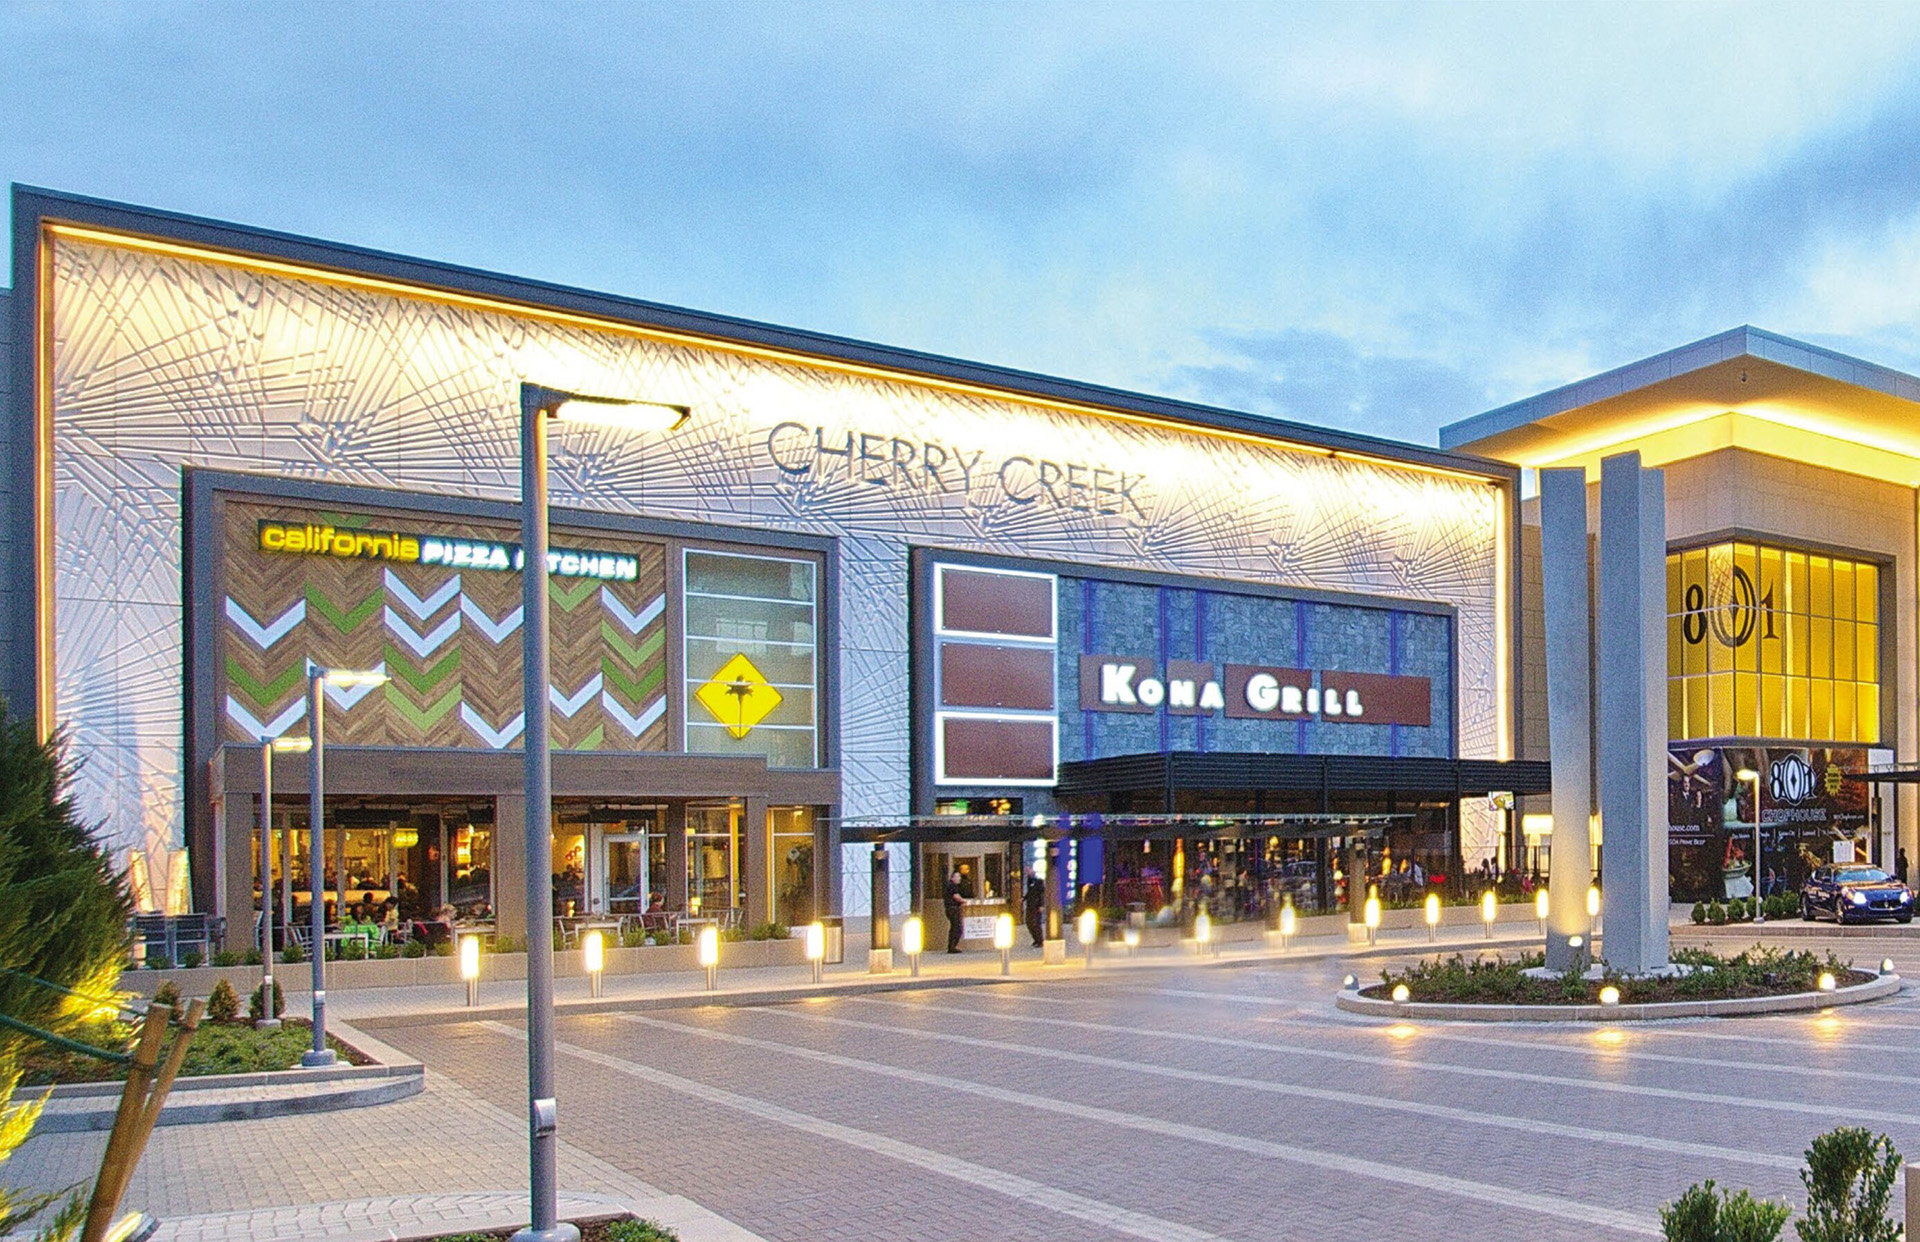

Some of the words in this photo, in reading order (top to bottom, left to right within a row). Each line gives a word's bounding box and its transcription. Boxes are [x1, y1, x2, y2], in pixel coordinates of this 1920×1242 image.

[767, 421, 984, 504] CHERRY
[999, 456, 1148, 519] CREEK
[262, 525, 420, 563] california
[421, 536, 511, 571] PIZZA
[514, 547, 638, 580] TCHEN
[1683, 564, 1780, 648] 801
[1100, 663, 1225, 710] KONA
[1246, 673, 1365, 717] GRILL
